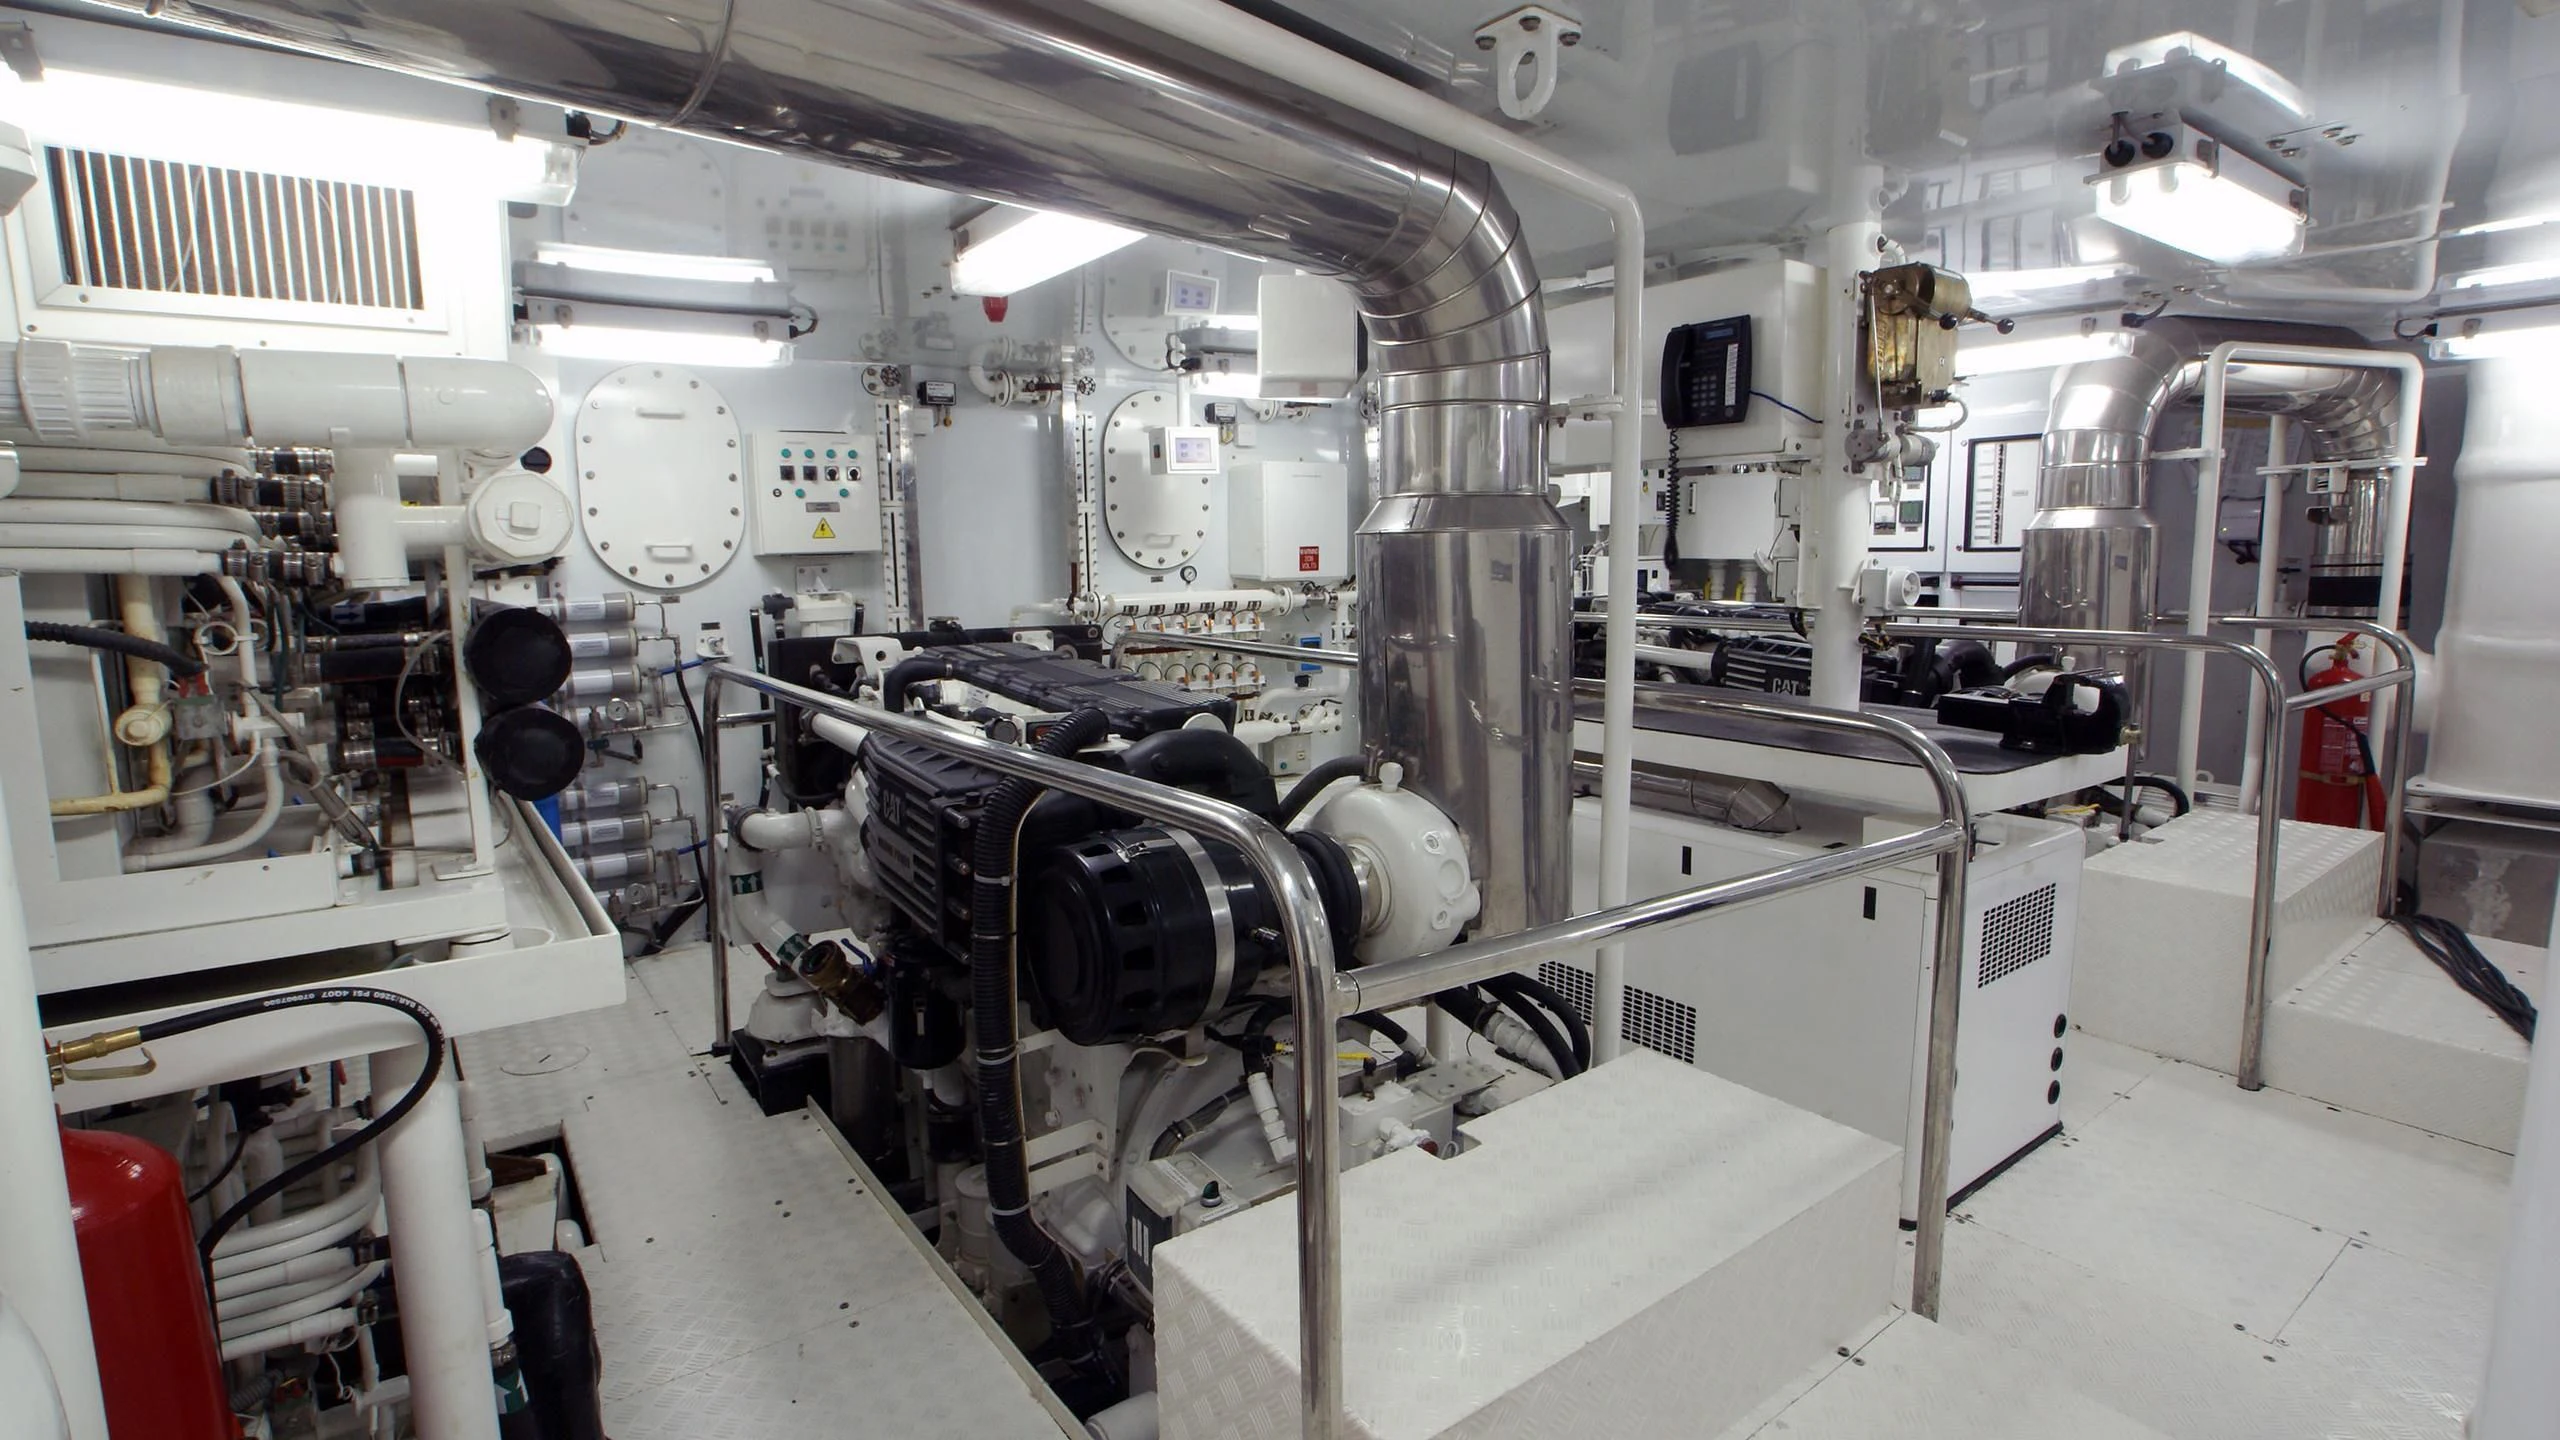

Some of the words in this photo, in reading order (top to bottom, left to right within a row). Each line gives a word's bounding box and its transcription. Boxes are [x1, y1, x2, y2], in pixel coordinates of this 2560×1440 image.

[1772, 678, 1799, 696] CAT
[883, 789, 900, 825] CAT
[321, 990, 349, 998] 4Q07
